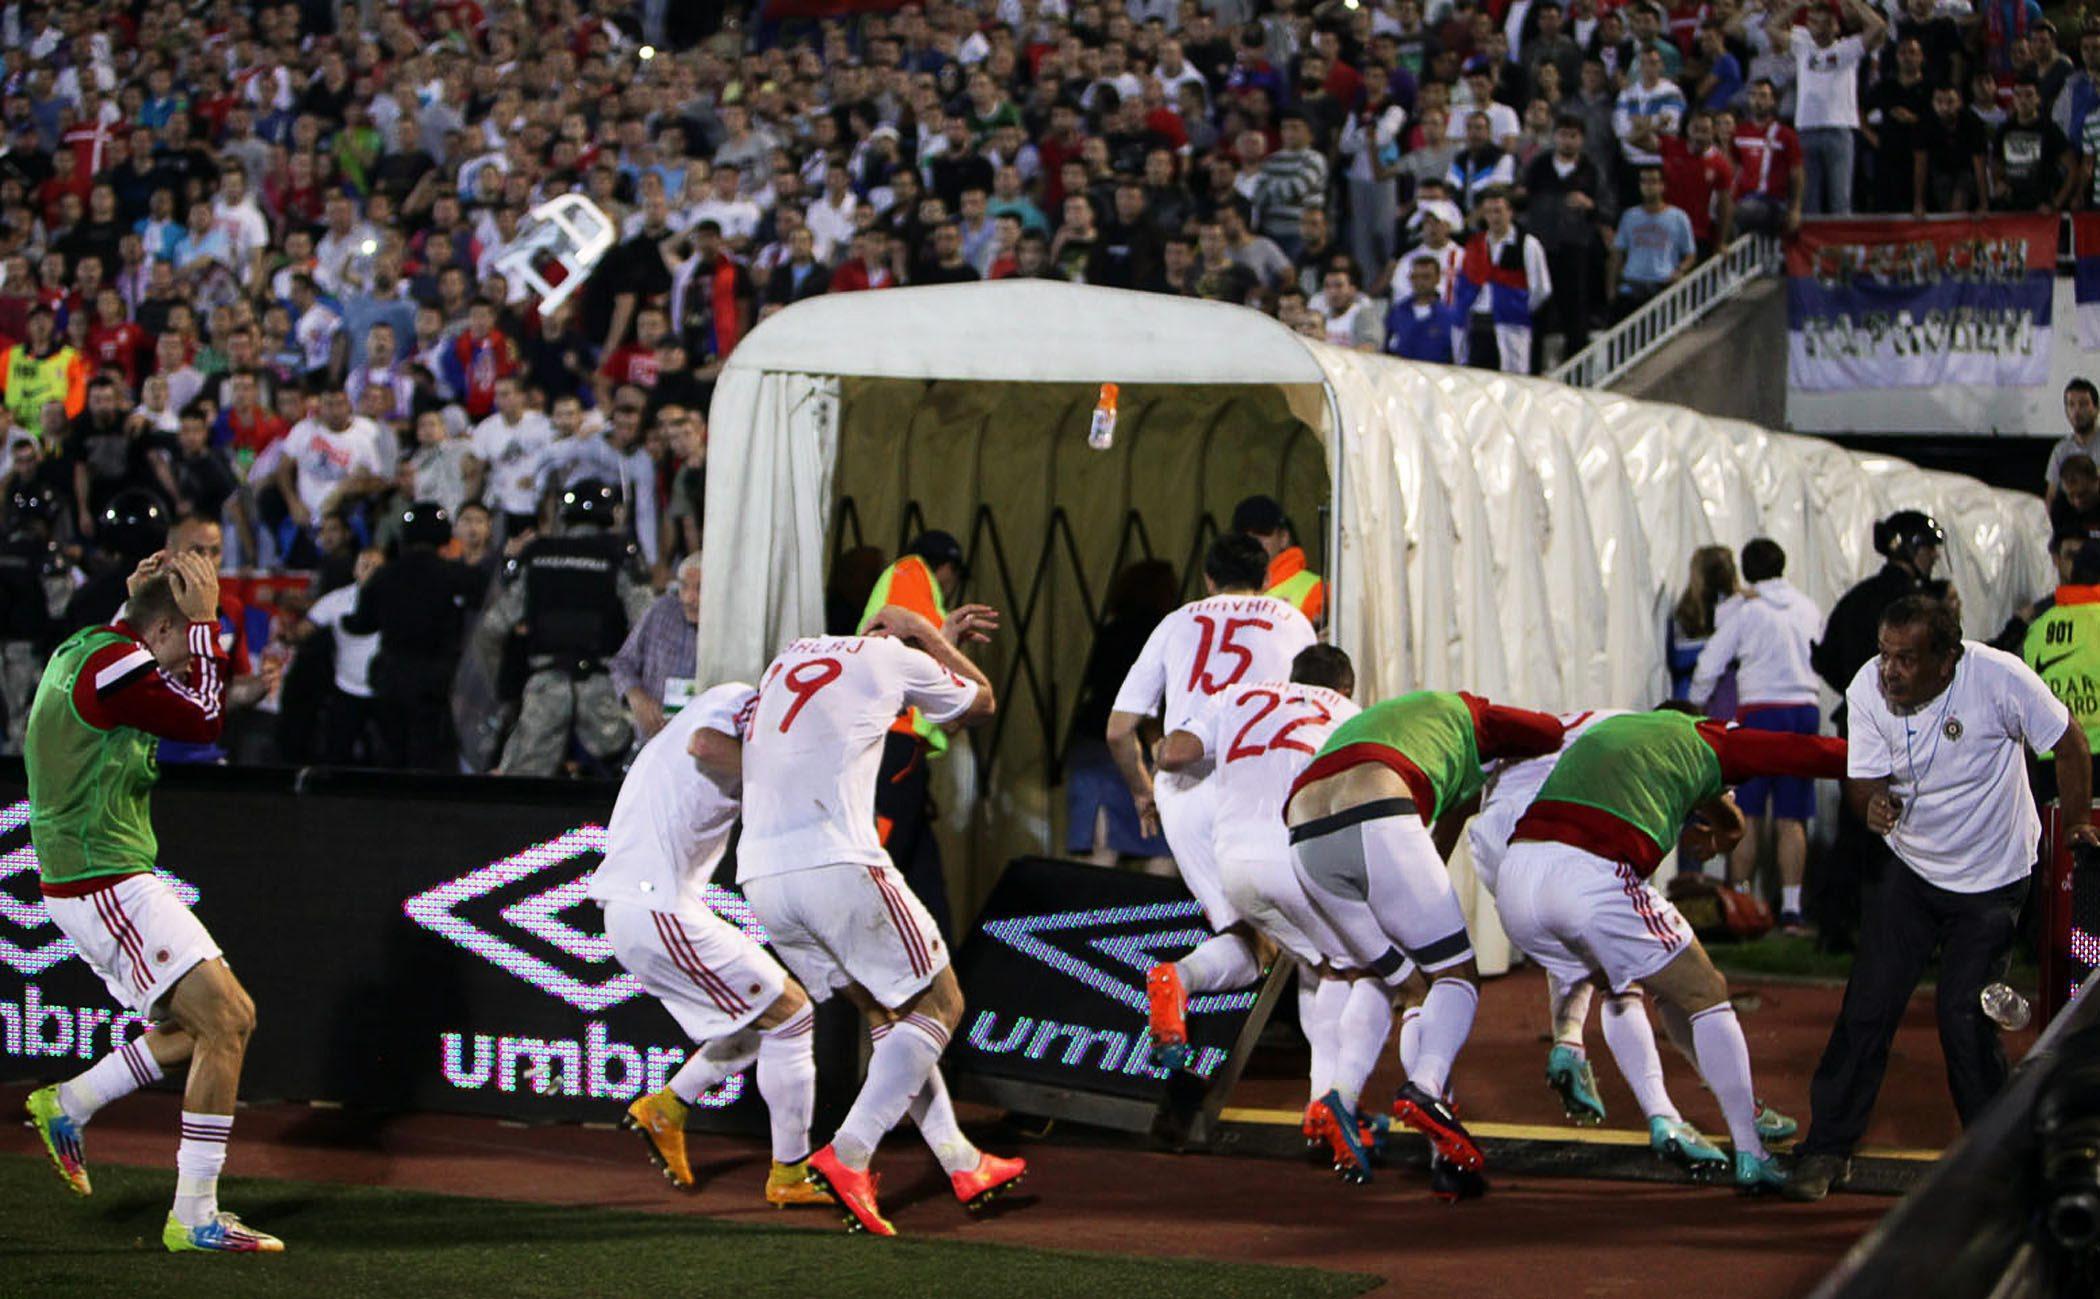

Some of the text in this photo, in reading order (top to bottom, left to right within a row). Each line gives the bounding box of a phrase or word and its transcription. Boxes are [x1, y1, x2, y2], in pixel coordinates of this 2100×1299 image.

[1187, 615, 1274, 696] 15
[747, 657, 843, 742] 19
[1226, 689, 1331, 764] 22
